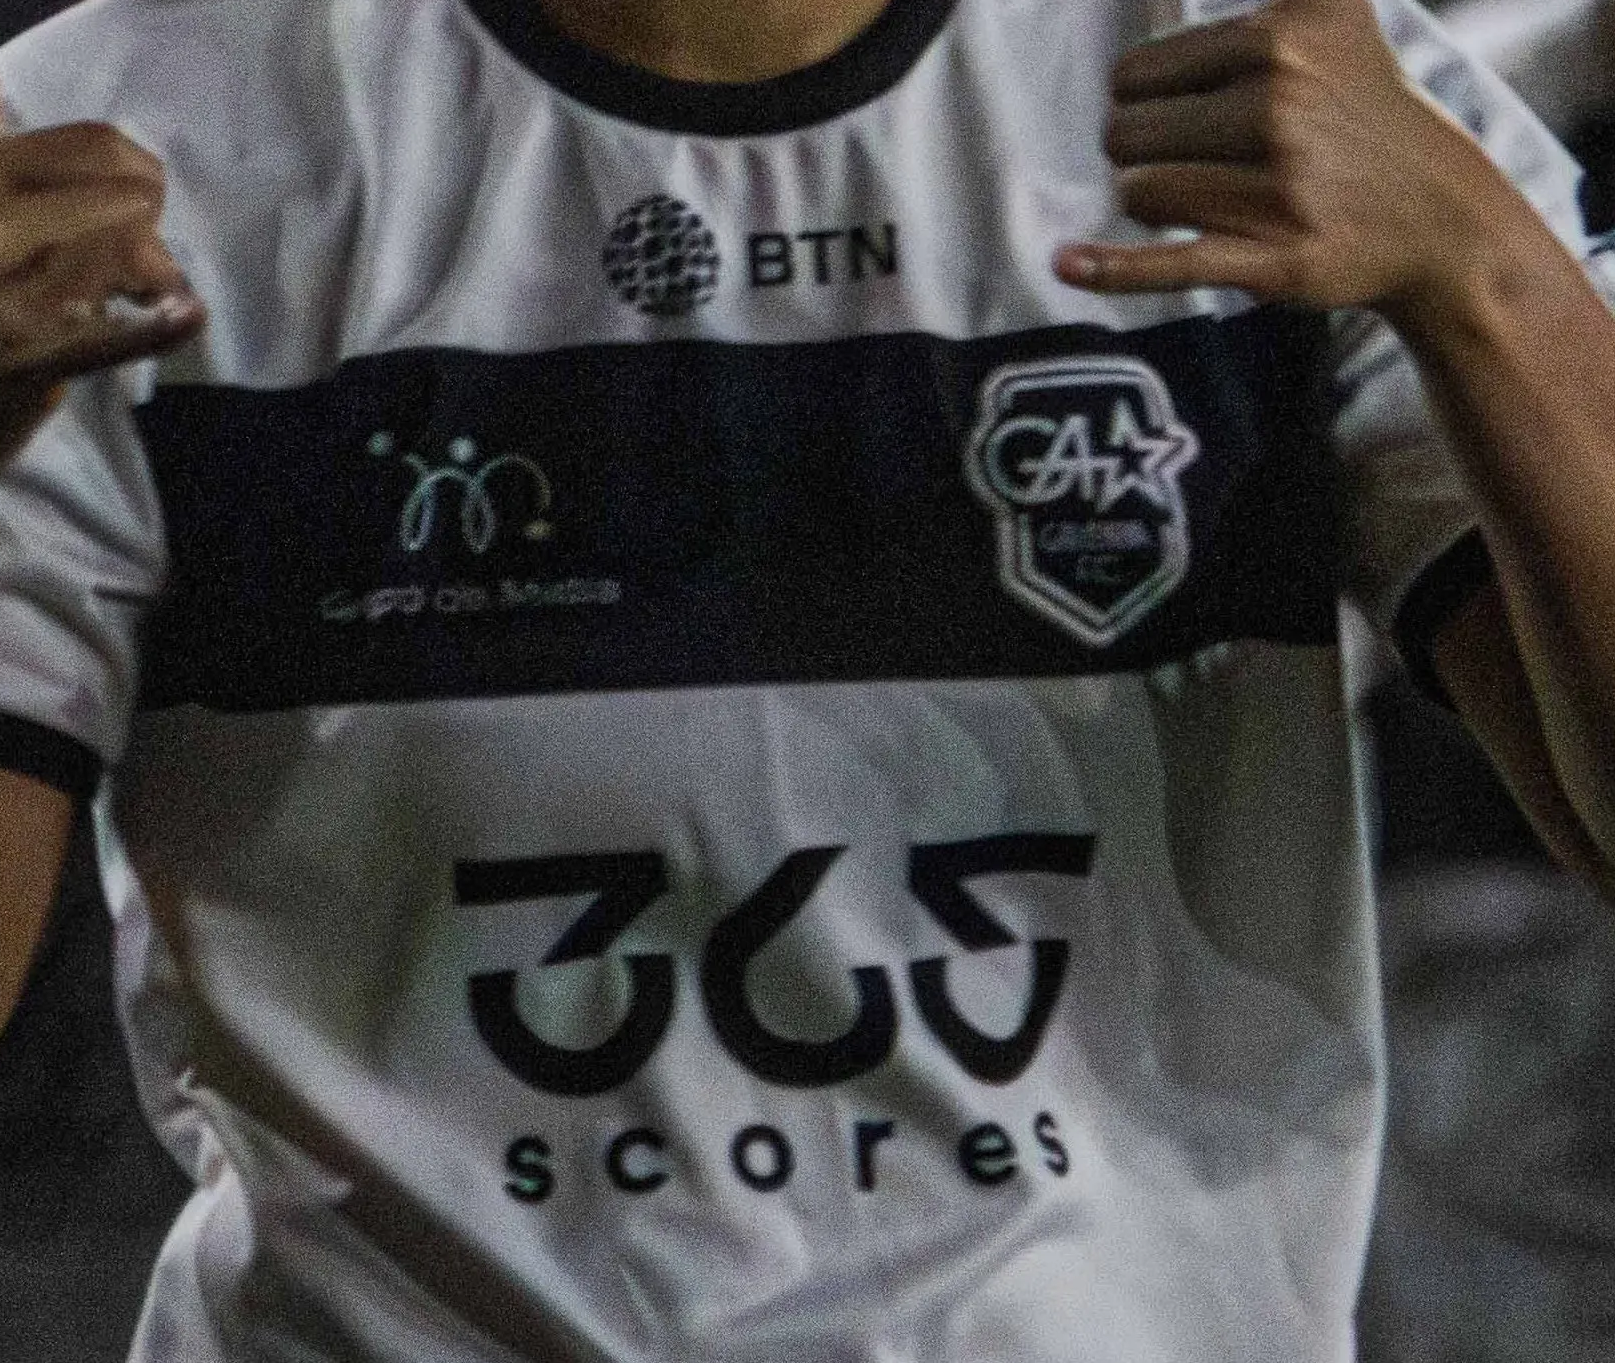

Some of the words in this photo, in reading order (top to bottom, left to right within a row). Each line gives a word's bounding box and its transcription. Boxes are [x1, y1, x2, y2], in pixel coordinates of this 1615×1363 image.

[748, 222, 898, 288] BTN
[454, 832, 1099, 1099] 365
[504, 1110, 1070, 1203] scores
